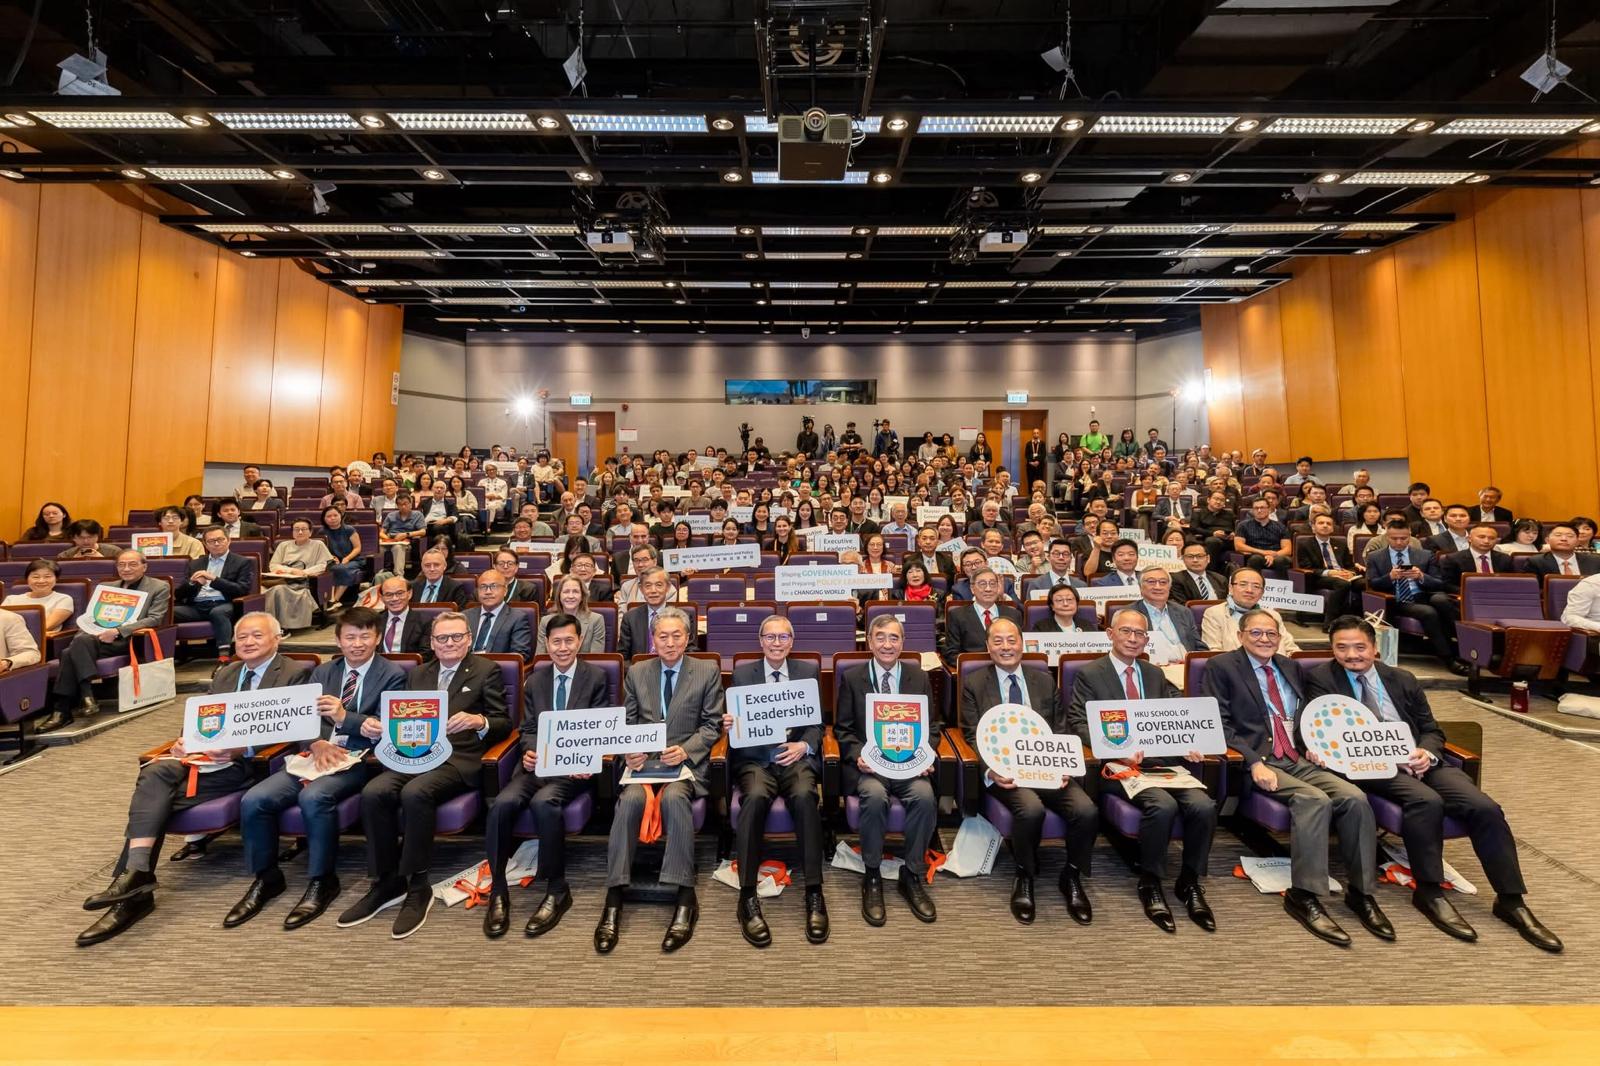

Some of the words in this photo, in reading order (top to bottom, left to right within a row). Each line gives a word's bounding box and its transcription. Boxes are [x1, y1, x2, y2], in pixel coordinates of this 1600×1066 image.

[1138, 547, 1172, 558] OPEN
[801, 569, 853, 577] GOVERNANCE
[824, 588, 846, 596] WORLD
[1277, 585, 1288, 594] of
[1261, 595, 1298, 605] ernance
[1299, 599, 1318, 607] and
[234, 702, 250, 711] HKU
[250, 699, 280, 709] SCHOOL
[281, 697, 292, 705] OF
[745, 689, 806, 705] Executive
[233, 705, 313, 724] GOVERNANCE
[747, 704, 815, 722] Leadership
[1150, 710, 1180, 718] SCHOOL
[1180, 709, 1190, 717] OF
[231, 729, 249, 737] AND
[249, 720, 292, 735] POLICY
[556, 719, 602, 732] Master
[604, 716, 619, 731] of
[748, 724, 774, 738] Hub
[1136, 719, 1215, 732] GOVERNANCE
[555, 735, 632, 749] Governance
[634, 730, 658, 744] and
[1139, 738, 1154, 746] AND
[1155, 733, 1195, 745] POLICY
[1342, 729, 1405, 743] GLOBAL
[1015, 739, 1076, 754] GLOBAL
[1346, 744, 1410, 758] LEADERS
[555, 752, 594, 767] Policy
[1016, 754, 1079, 769] LEADERS
[1350, 759, 1389, 772] Series
[1017, 767, 1056, 781] Series
